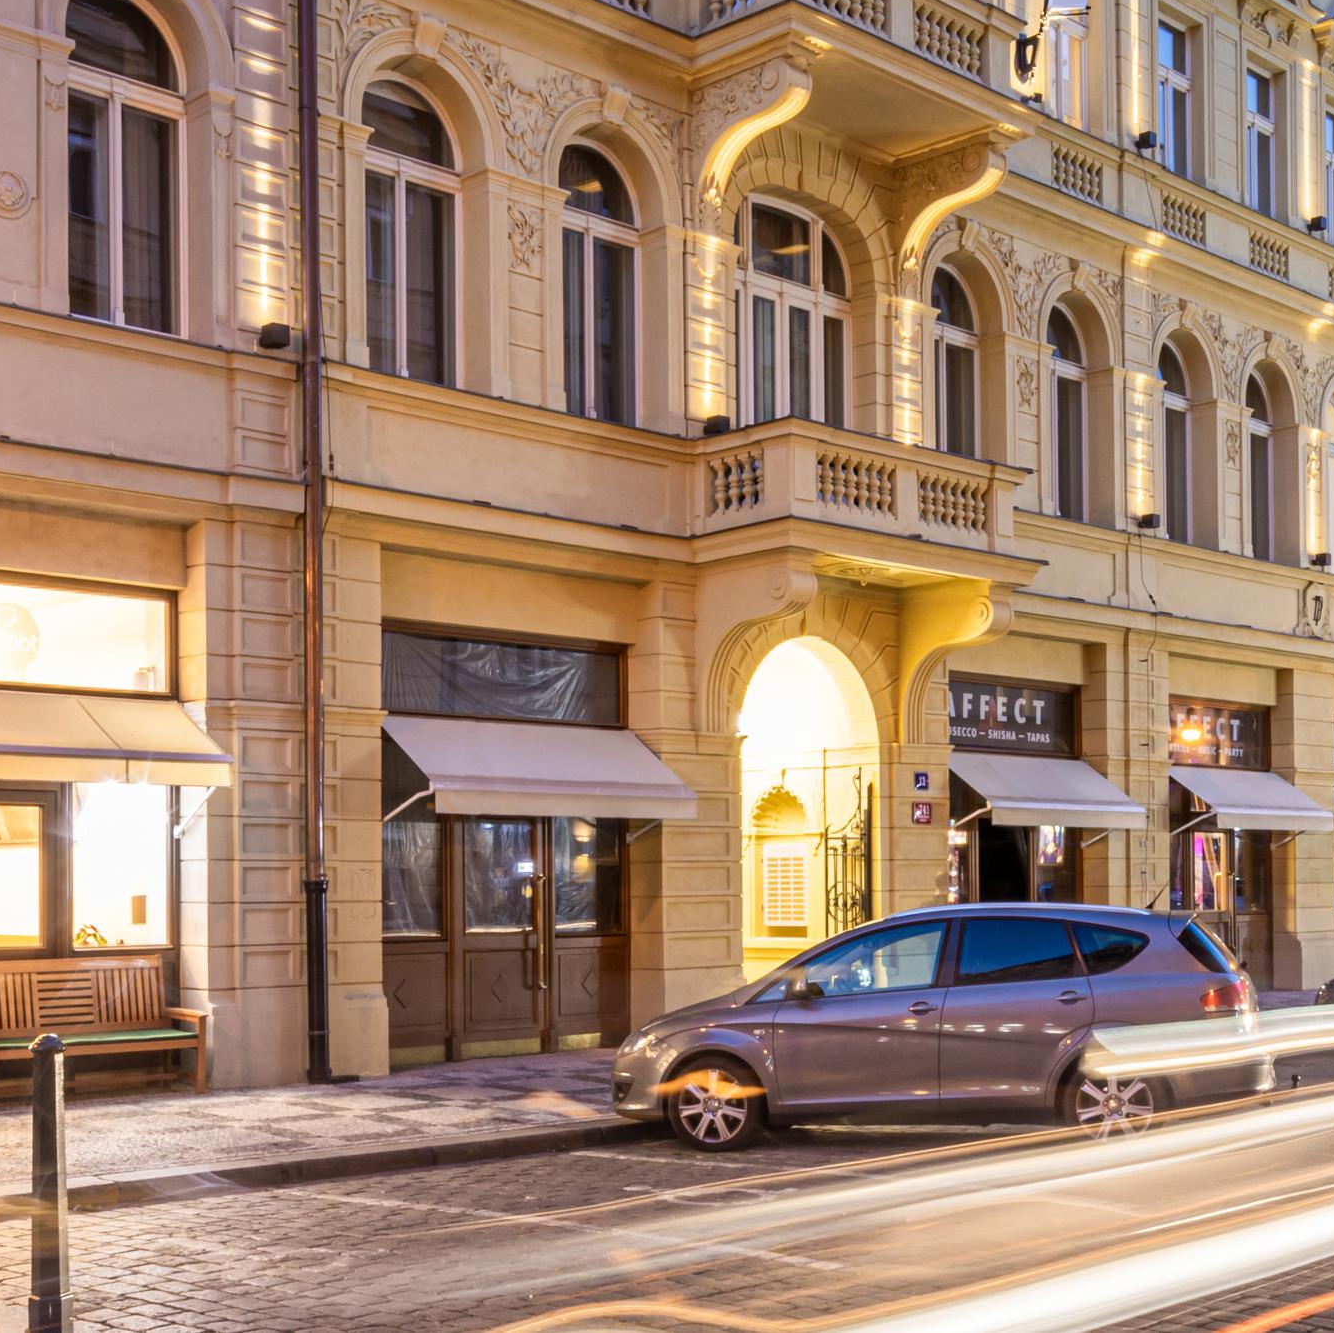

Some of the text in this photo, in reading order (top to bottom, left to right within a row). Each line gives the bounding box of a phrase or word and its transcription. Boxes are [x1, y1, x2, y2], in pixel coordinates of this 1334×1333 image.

[988, 729, 1017, 741] SHISHA
[1027, 732, 1050, 743] TAPAS
[1224, 747, 1244, 757] PARTY
